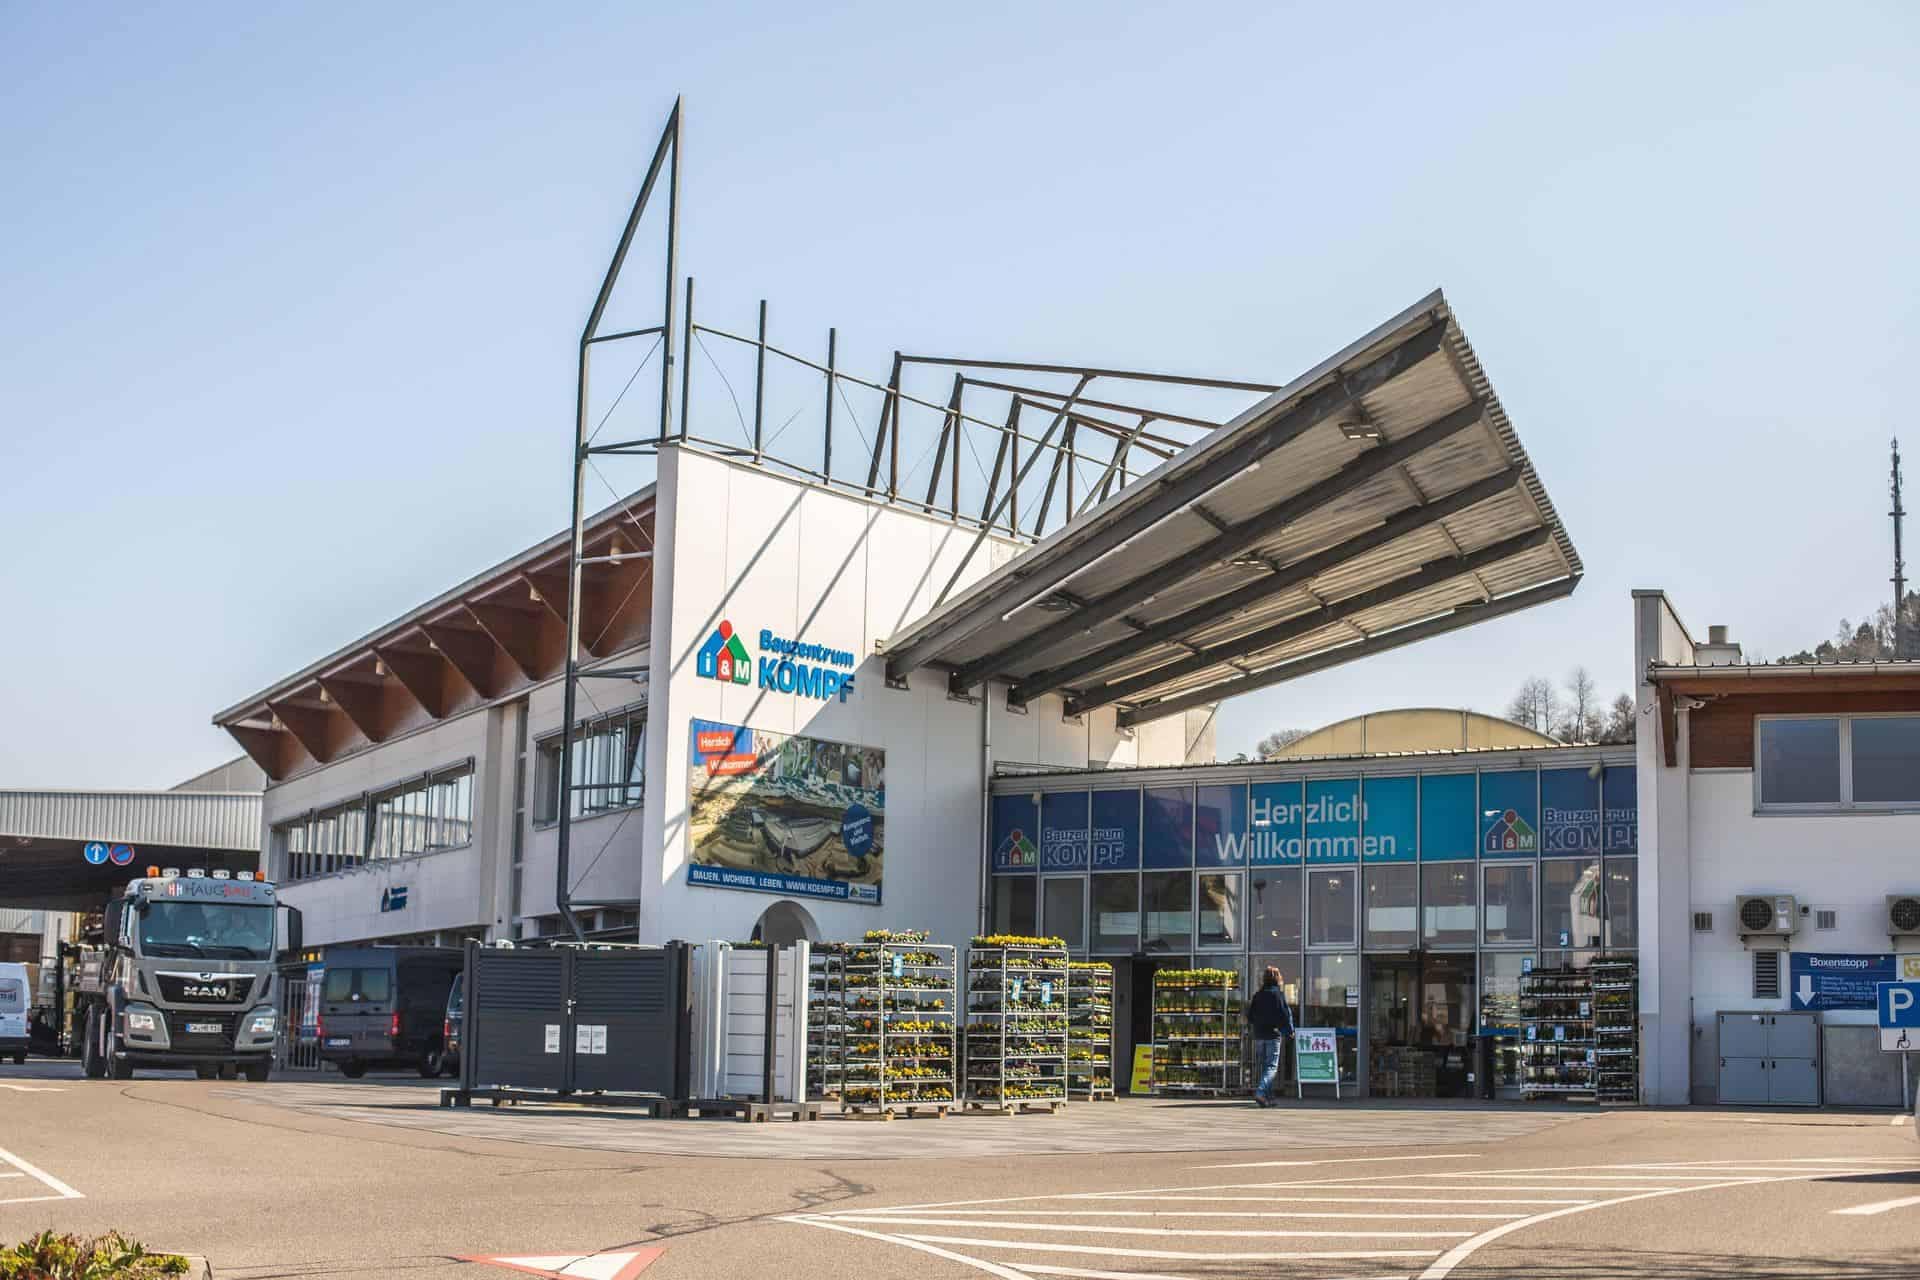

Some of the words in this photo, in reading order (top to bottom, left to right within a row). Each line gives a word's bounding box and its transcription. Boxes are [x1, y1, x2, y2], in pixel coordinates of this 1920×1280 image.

[760, 629, 855, 668] Bauzentrum
[705, 651, 749, 680] i&M
[758, 654, 855, 703] KÖMPF
[1251, 794, 1369, 826] Herzlich
[1043, 828, 1123, 841] Bauzentrum
[1215, 831, 1396, 861] Willkommen
[693, 870, 720, 882] BAUEN.
[723, 873, 755, 886] WOHNEN.
[759, 877, 784, 889] LEBEN.
[786, 880, 845, 896] WWW.KOEMPF.DE
[1810, 957, 1869, 968] Boxenstopp
[184, 986, 226, 997] MAN
[1888, 988, 1914, 1024] P
